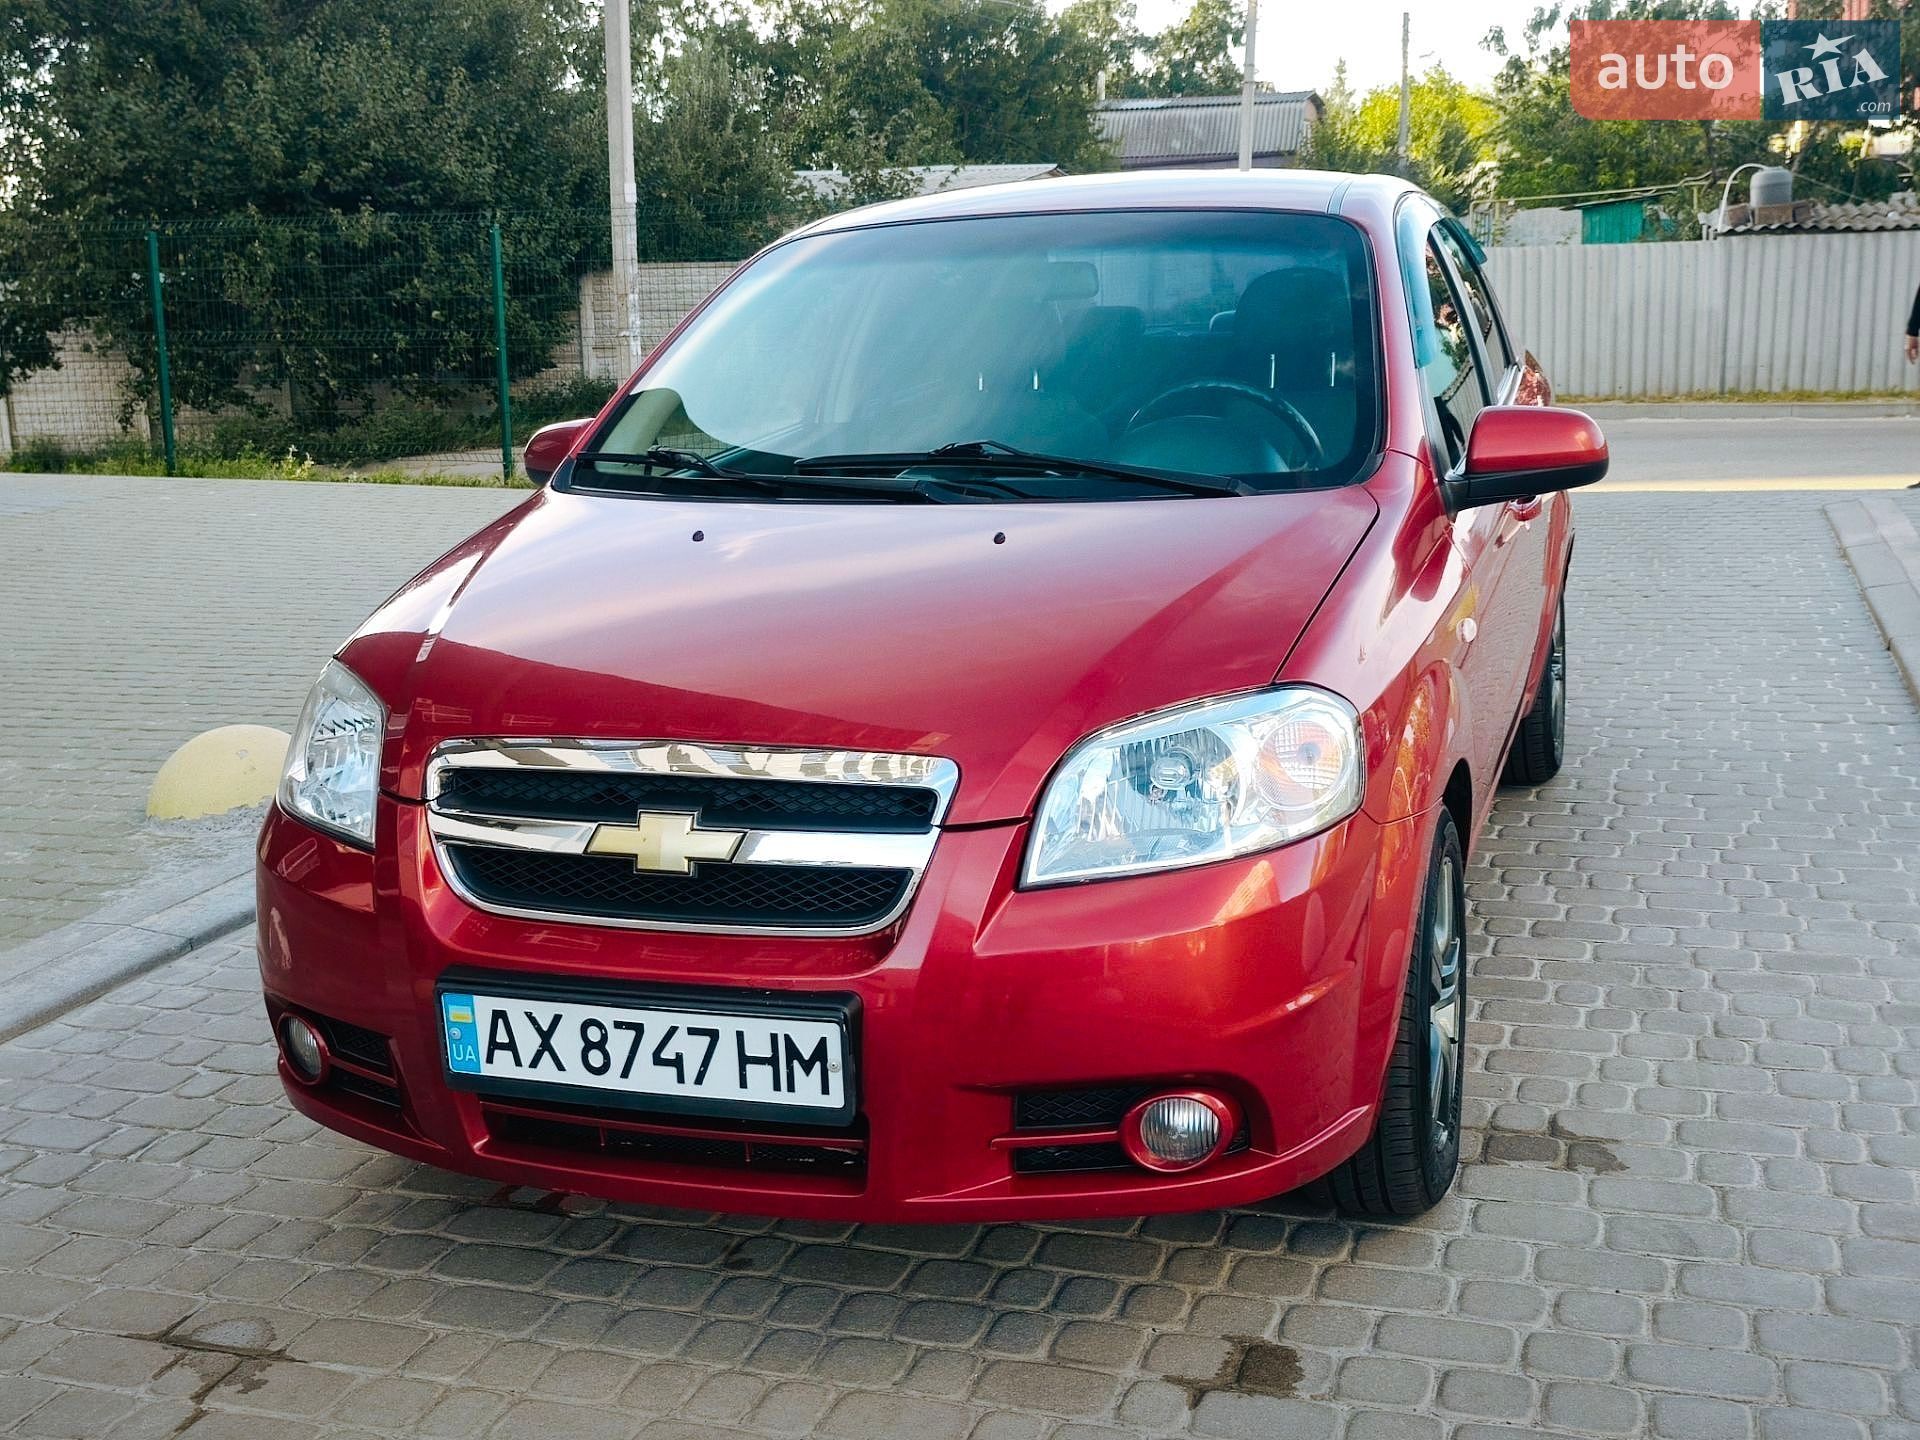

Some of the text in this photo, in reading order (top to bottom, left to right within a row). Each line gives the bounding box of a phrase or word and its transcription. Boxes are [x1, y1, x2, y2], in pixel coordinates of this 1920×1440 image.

[452, 1043, 477, 1063] UA
[485, 1009, 830, 1096] AX 8747 HM
